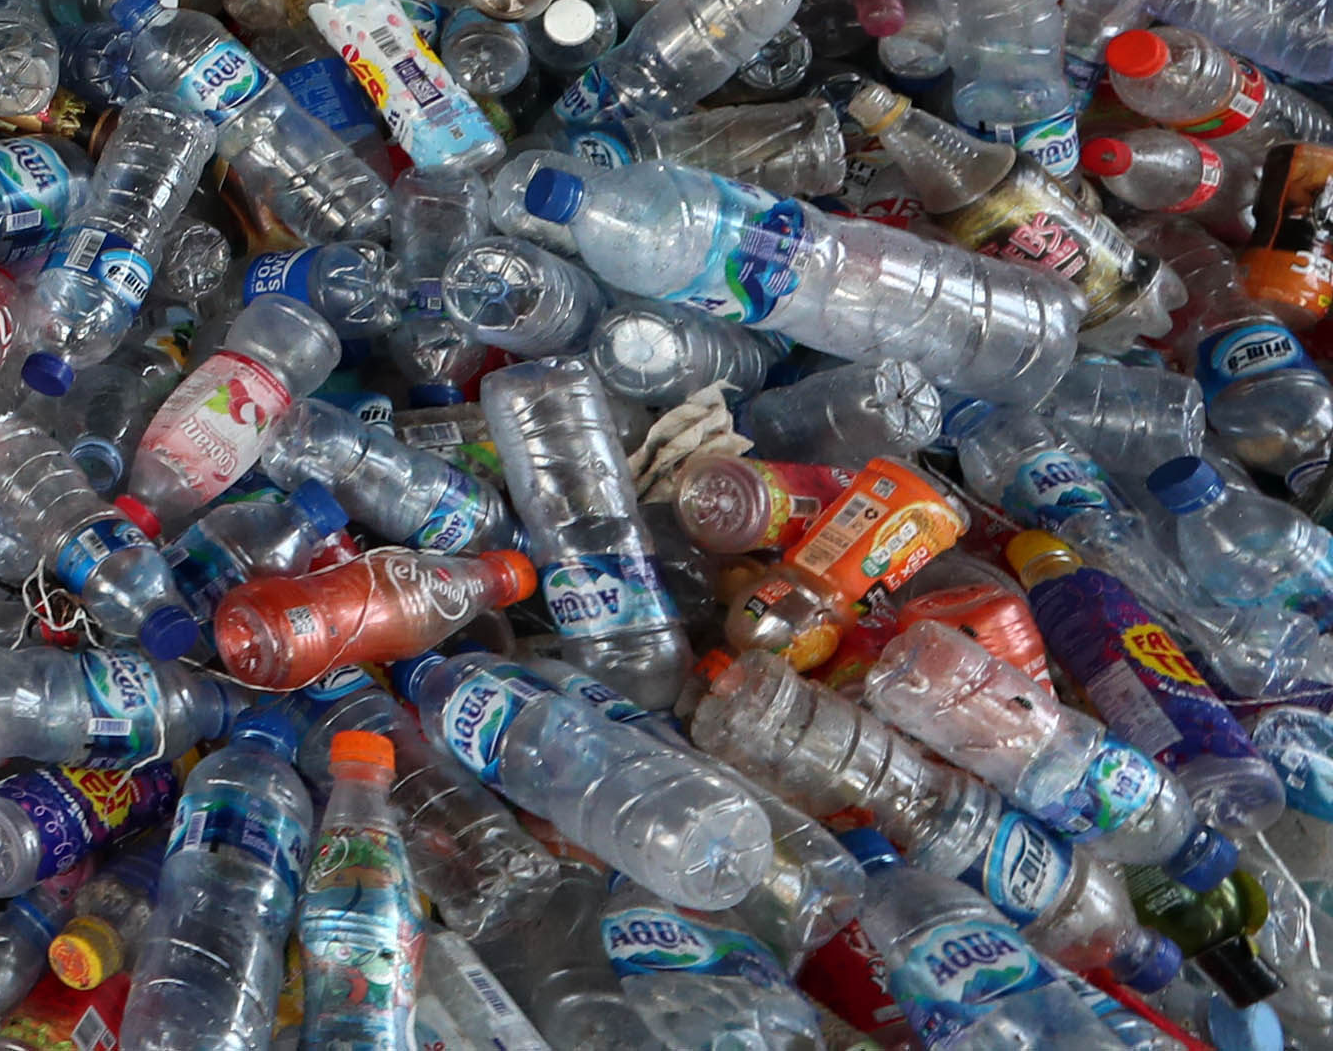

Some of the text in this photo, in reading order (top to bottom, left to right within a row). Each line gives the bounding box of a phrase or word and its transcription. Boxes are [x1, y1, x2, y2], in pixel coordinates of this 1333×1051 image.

[197, 51, 246, 101] AQUA
[108, 266, 148, 300] prim-a
[1227, 337, 1293, 372] prim-a
[431, 513, 464, 551] AQUA
[552, 587, 620, 623] AQUA
[451, 684, 497, 759] AQUA
[608, 920, 702, 949] AQUA
[928, 930, 1016, 983] AQUA
